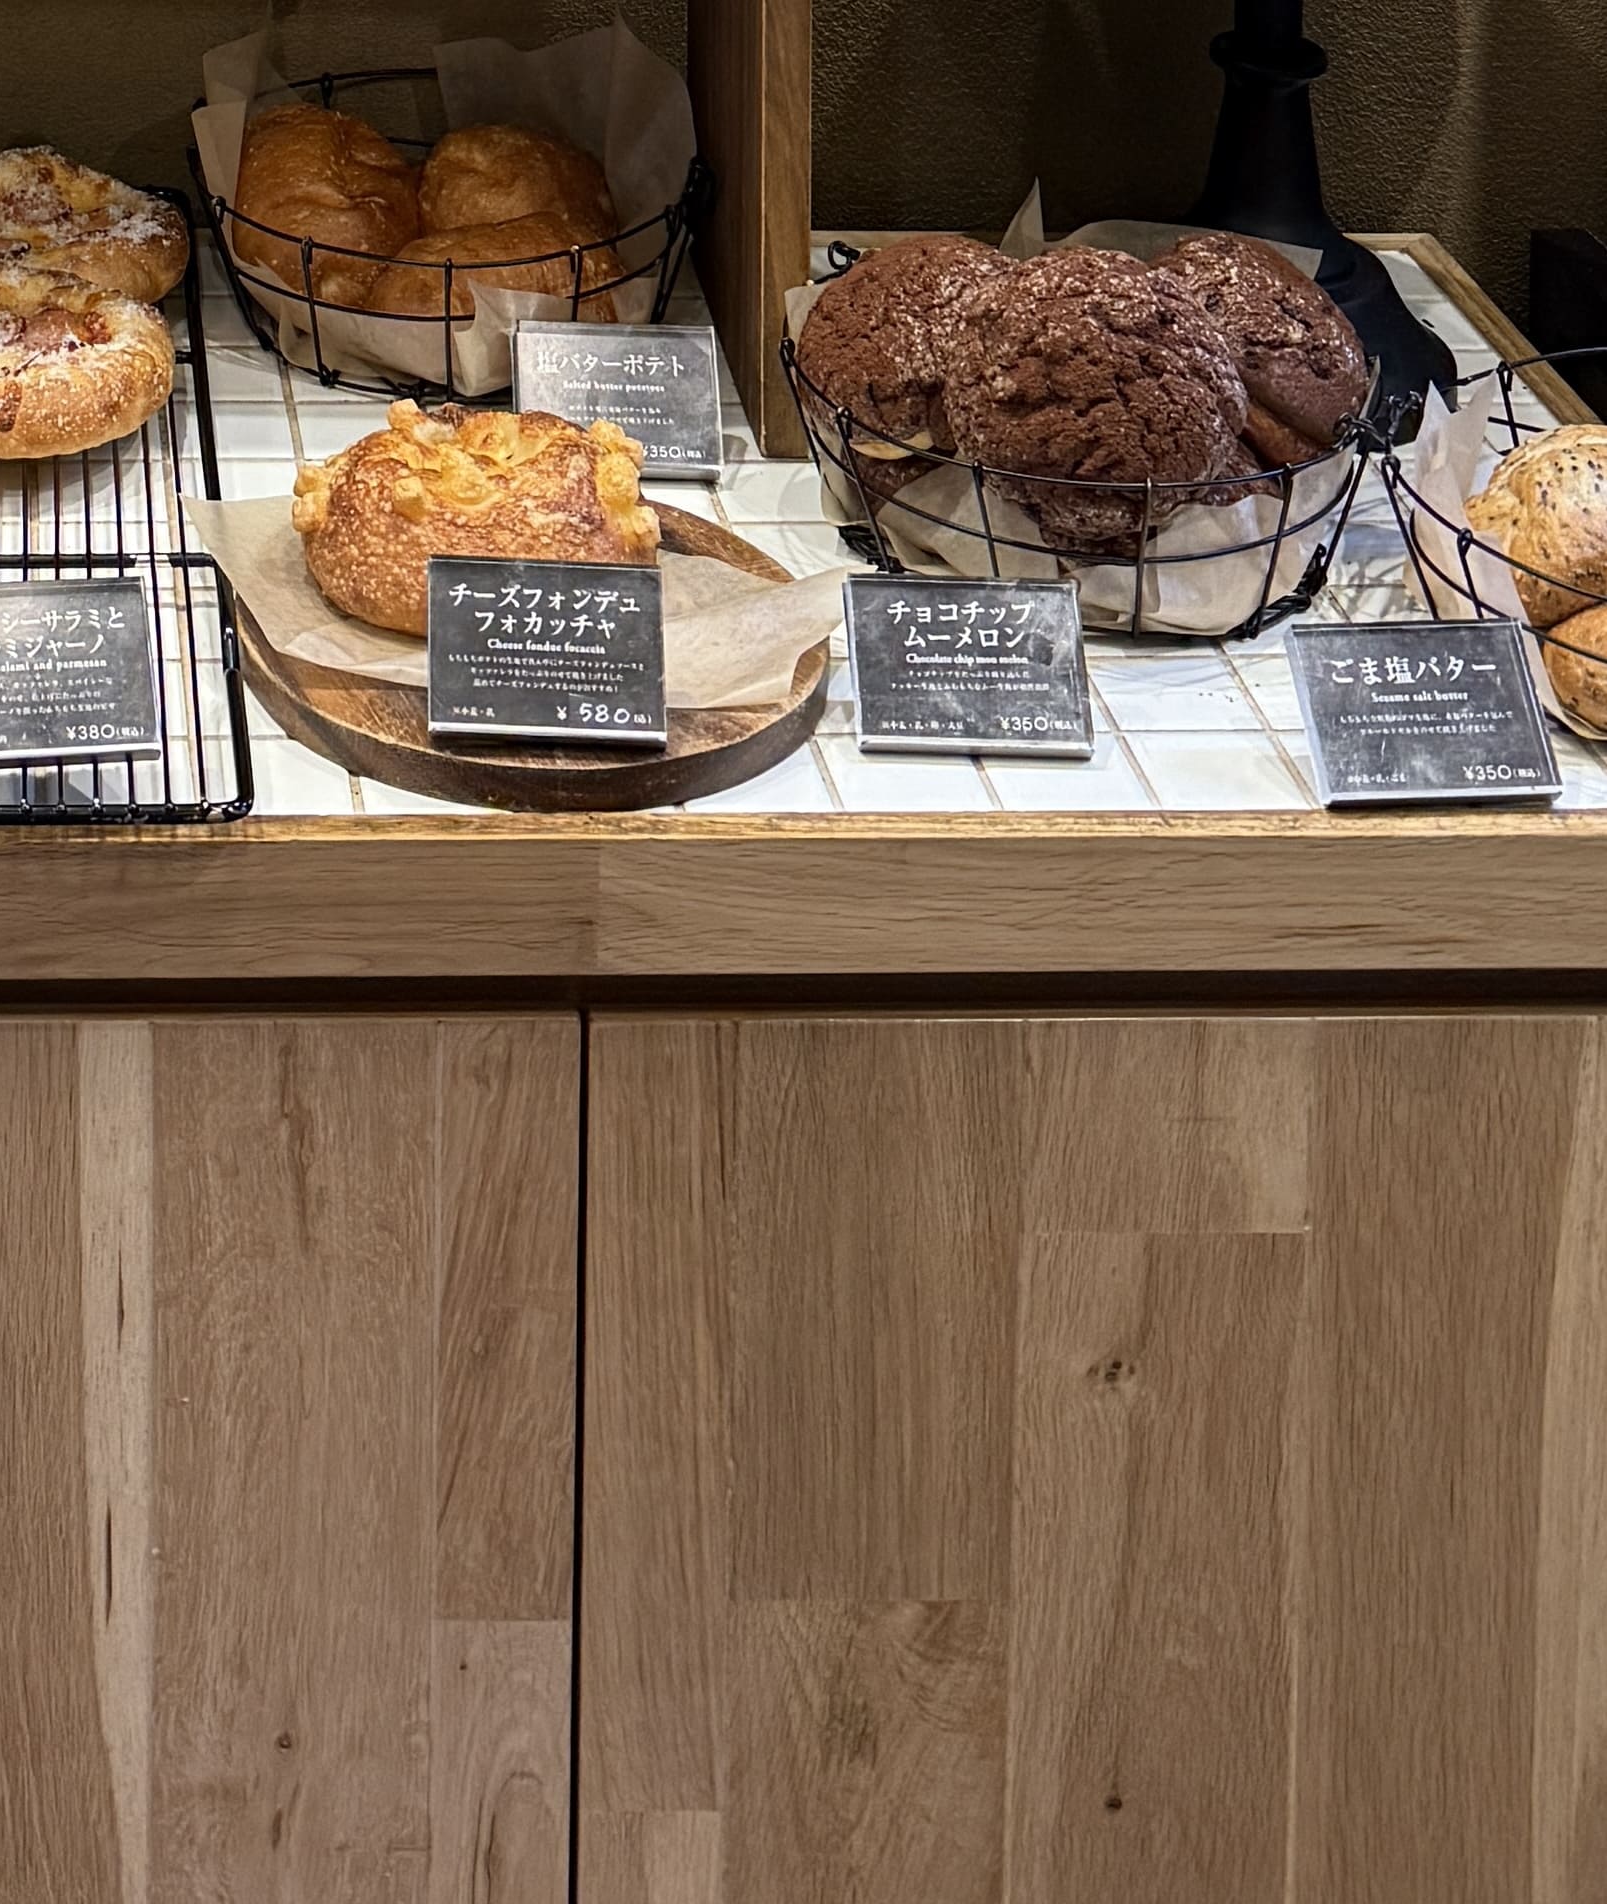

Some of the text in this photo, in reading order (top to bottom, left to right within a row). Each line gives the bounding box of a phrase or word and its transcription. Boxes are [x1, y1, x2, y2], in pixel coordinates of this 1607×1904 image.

[536, 351, 684, 377] 塩バターポテト
[593, 380, 623, 391] butter
[449, 582, 640, 614] チーズフォンデュ
[887, 600, 1035, 625] チョコチップ
[474, 610, 616, 639] フォカッチャ
[487, 638, 606, 655] Cheese fondue focaccia
[903, 626, 1026, 649] ムーメロン
[33, 659, 53, 671] and
[56, 658, 108, 672] parmesan
[905, 653, 1029, 667] Chocolate chip mou melon
[1371, 689, 1469, 704] Sesame salt butter
